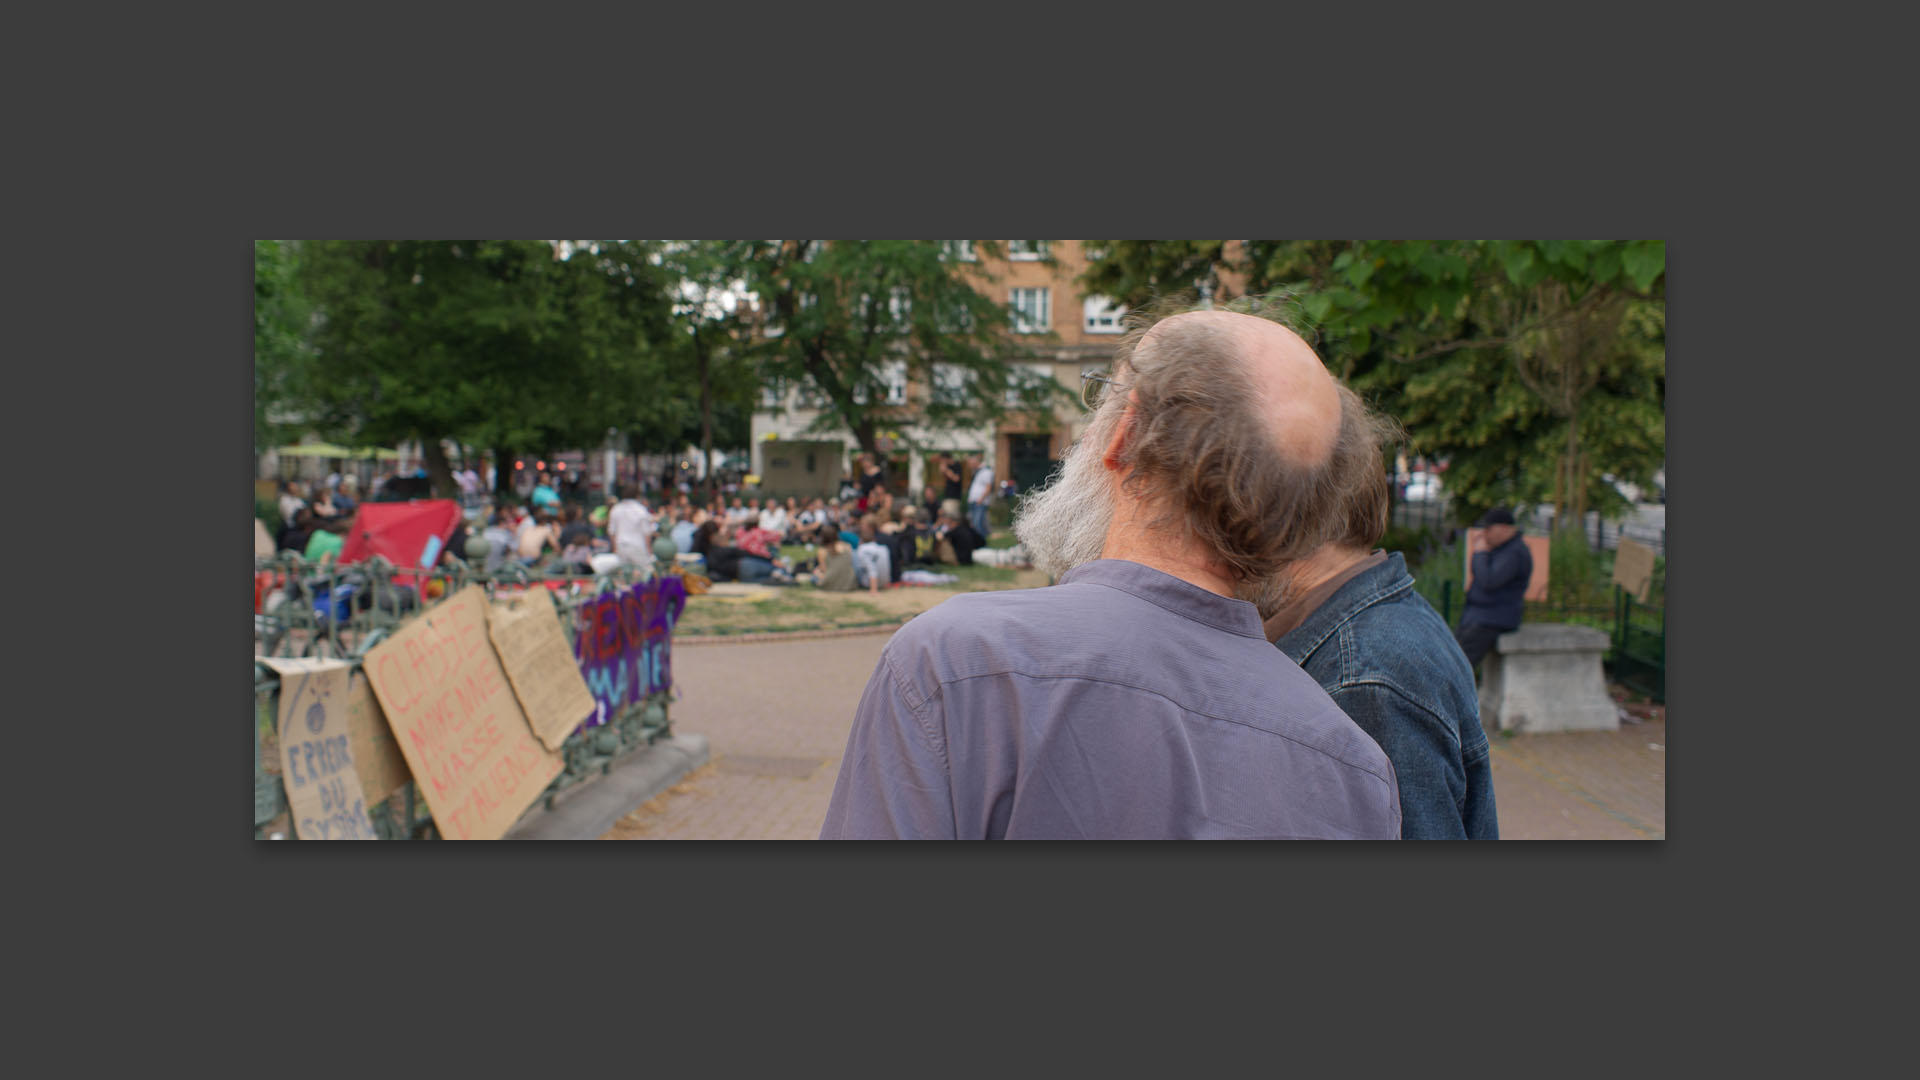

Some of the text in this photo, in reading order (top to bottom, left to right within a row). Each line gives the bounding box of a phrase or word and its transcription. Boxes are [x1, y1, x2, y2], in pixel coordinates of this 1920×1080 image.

[376, 603, 484, 714] CLASSE
[317, 775, 346, 814] DU
[431, 713, 504, 802] MASSE
